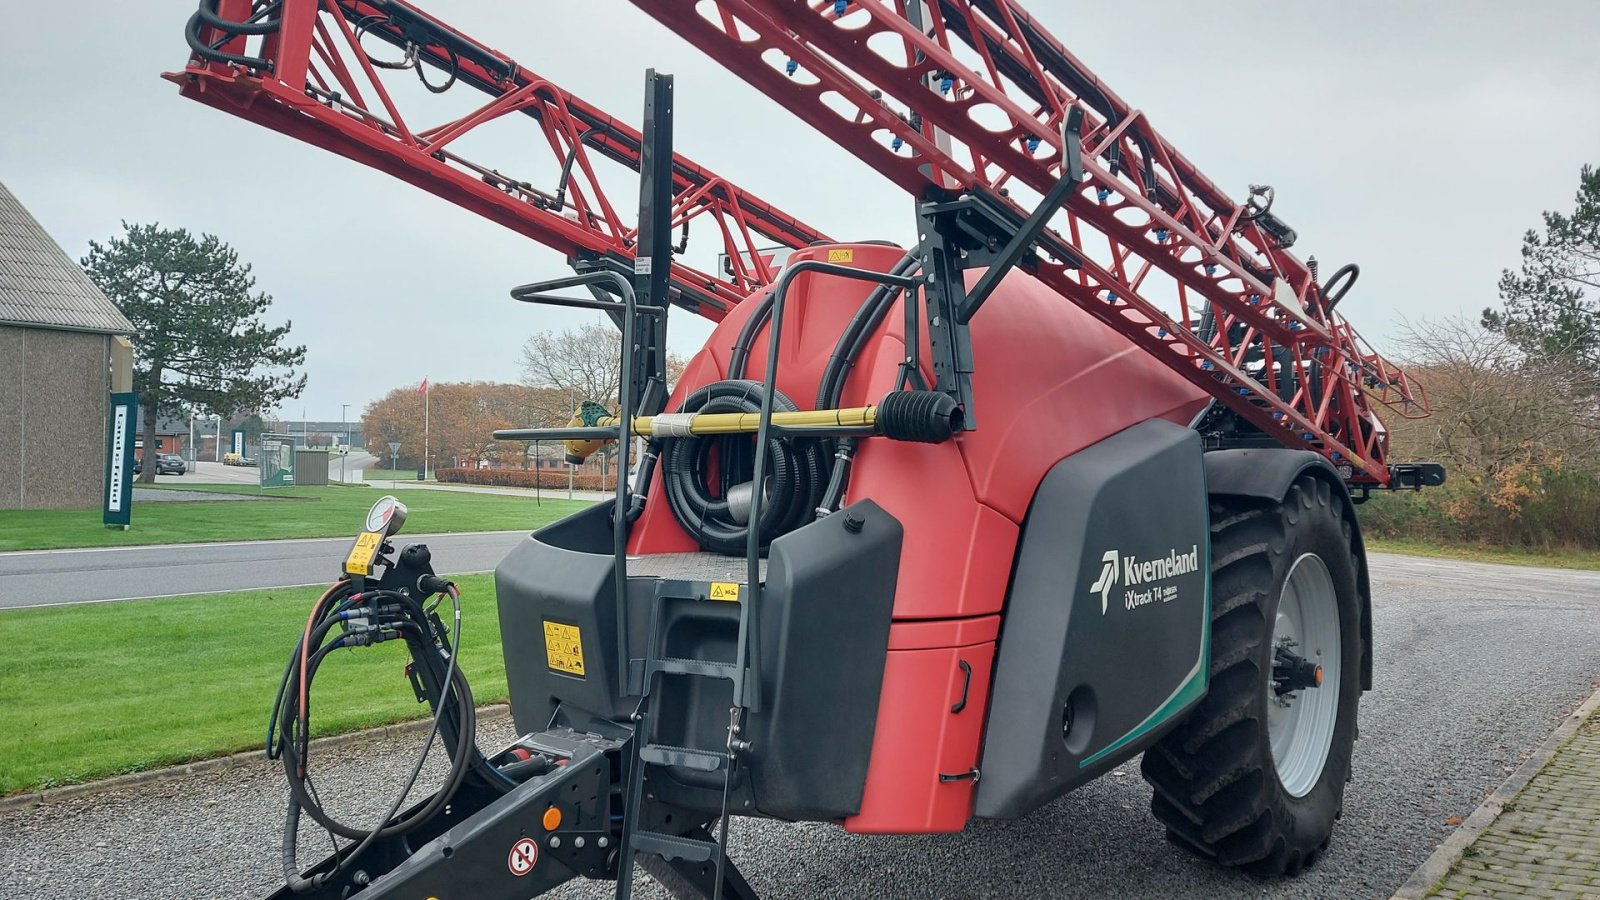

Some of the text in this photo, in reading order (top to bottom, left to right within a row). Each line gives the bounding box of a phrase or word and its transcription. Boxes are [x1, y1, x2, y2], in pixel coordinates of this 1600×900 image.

[1124, 545, 1198, 586] Kverneland
[1124, 589, 1152, 610] iXtrack
[1153, 587, 1162, 602] T4
